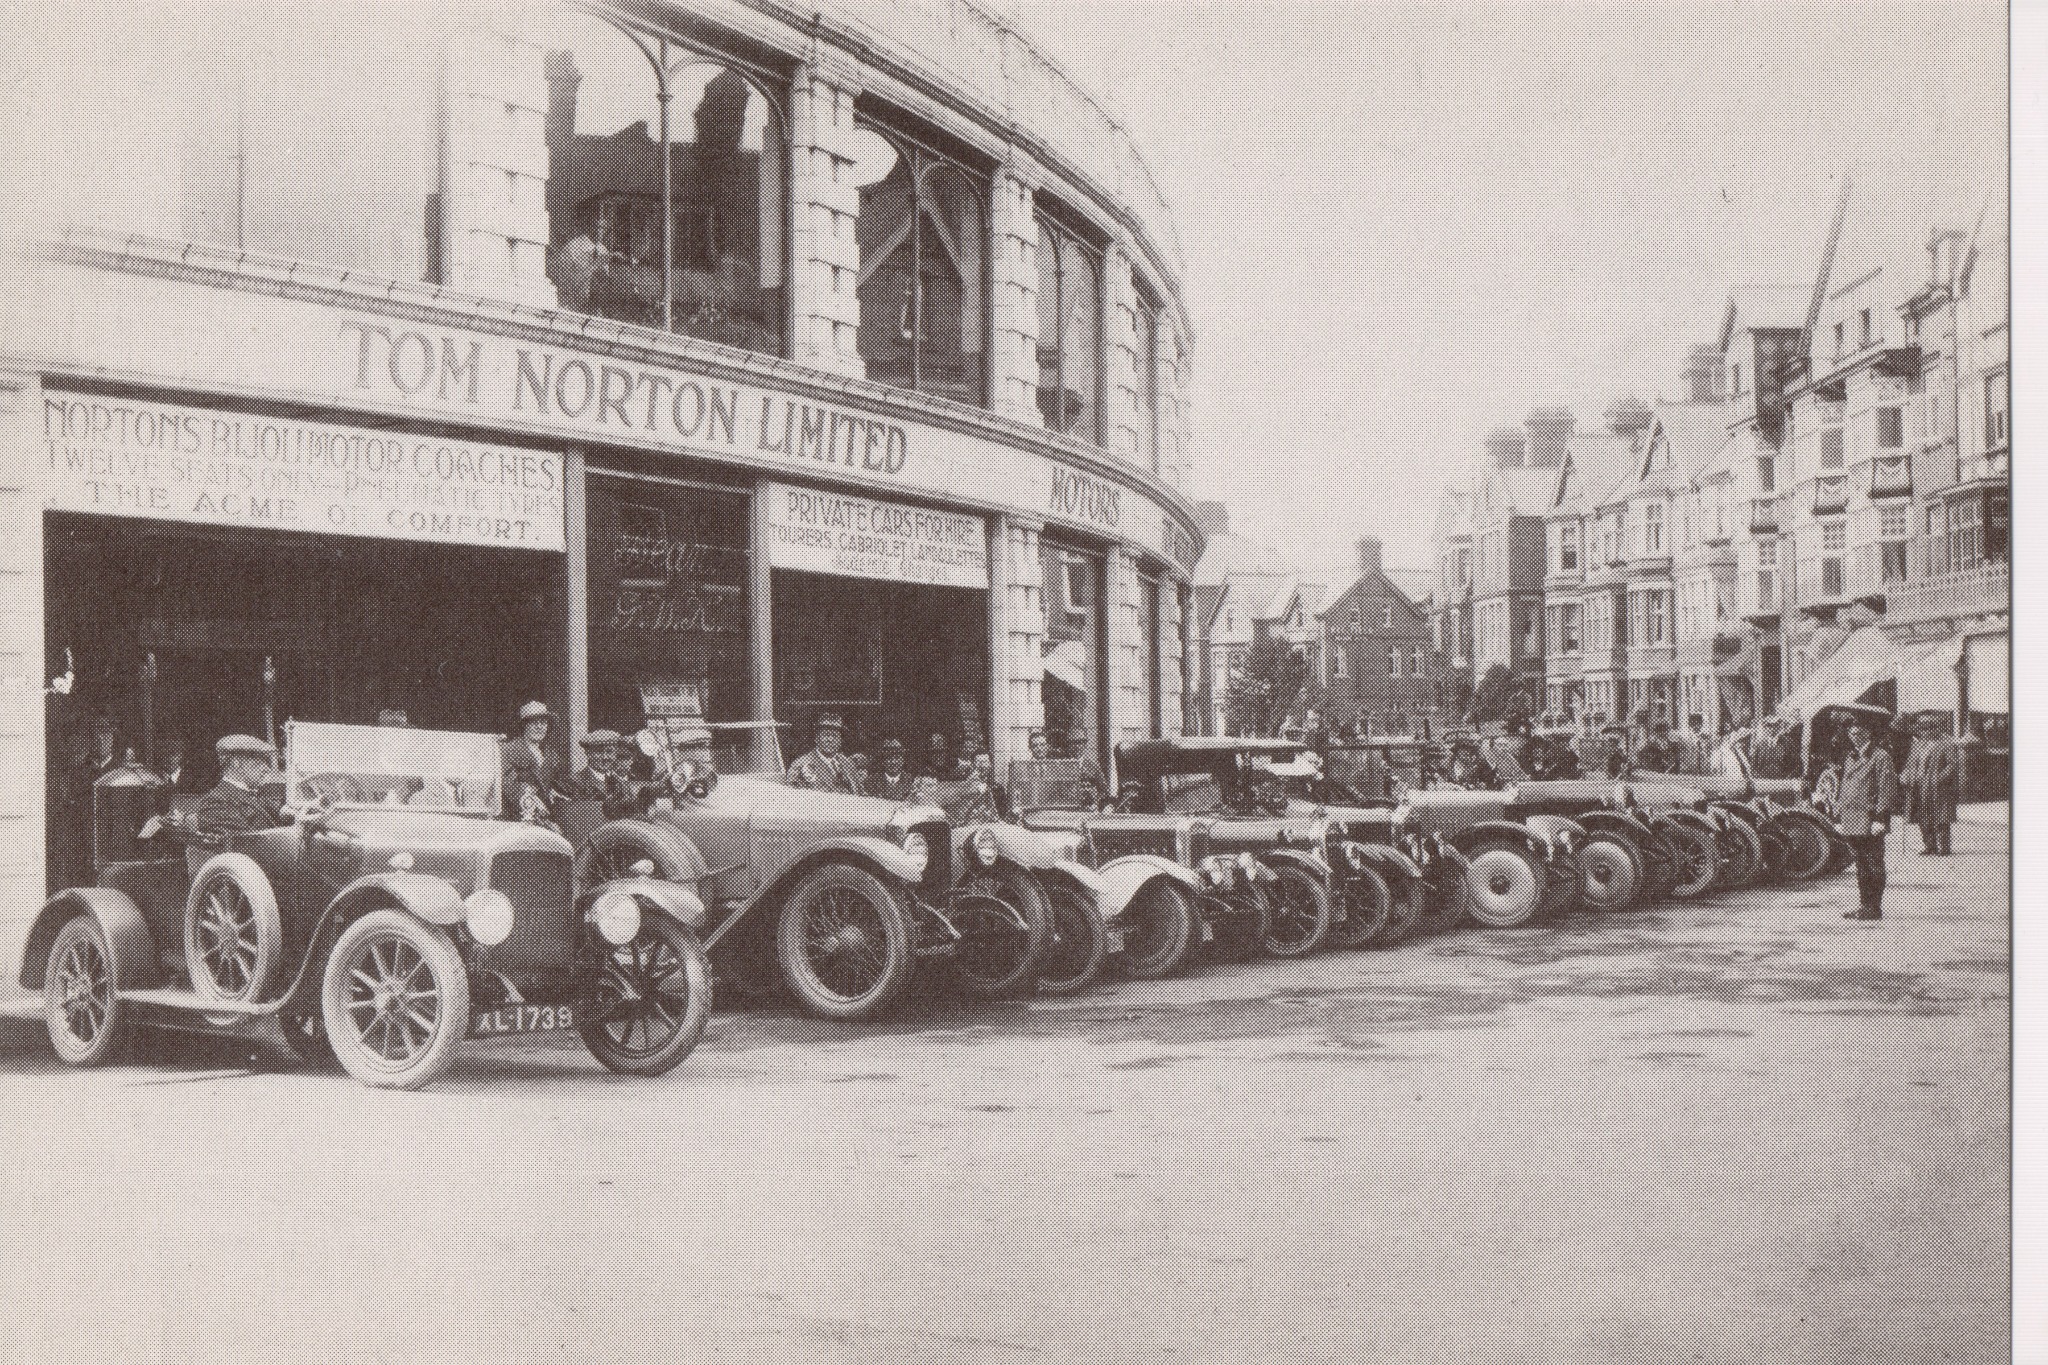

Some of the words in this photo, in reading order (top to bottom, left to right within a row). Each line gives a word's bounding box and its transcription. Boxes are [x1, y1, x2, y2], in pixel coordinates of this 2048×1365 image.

[210, 418, 303, 465] BIJOU
[307, 430, 404, 475] MOTOR
[341, 320, 483, 404] TOM
[512, 348, 739, 445] NORTON
[757, 396, 908, 475] LIMITED
[1049, 465, 1121, 528] MOTORS
[43, 439, 158, 481] TWELVE
[170, 456, 254, 490] SEATS
[85, 480, 170, 510] THE
[192, 491, 299, 521] ACME
[787, 491, 868, 533] PRIVATE
[870, 505, 913, 539] CARS
[914, 512, 943, 543] FOR
